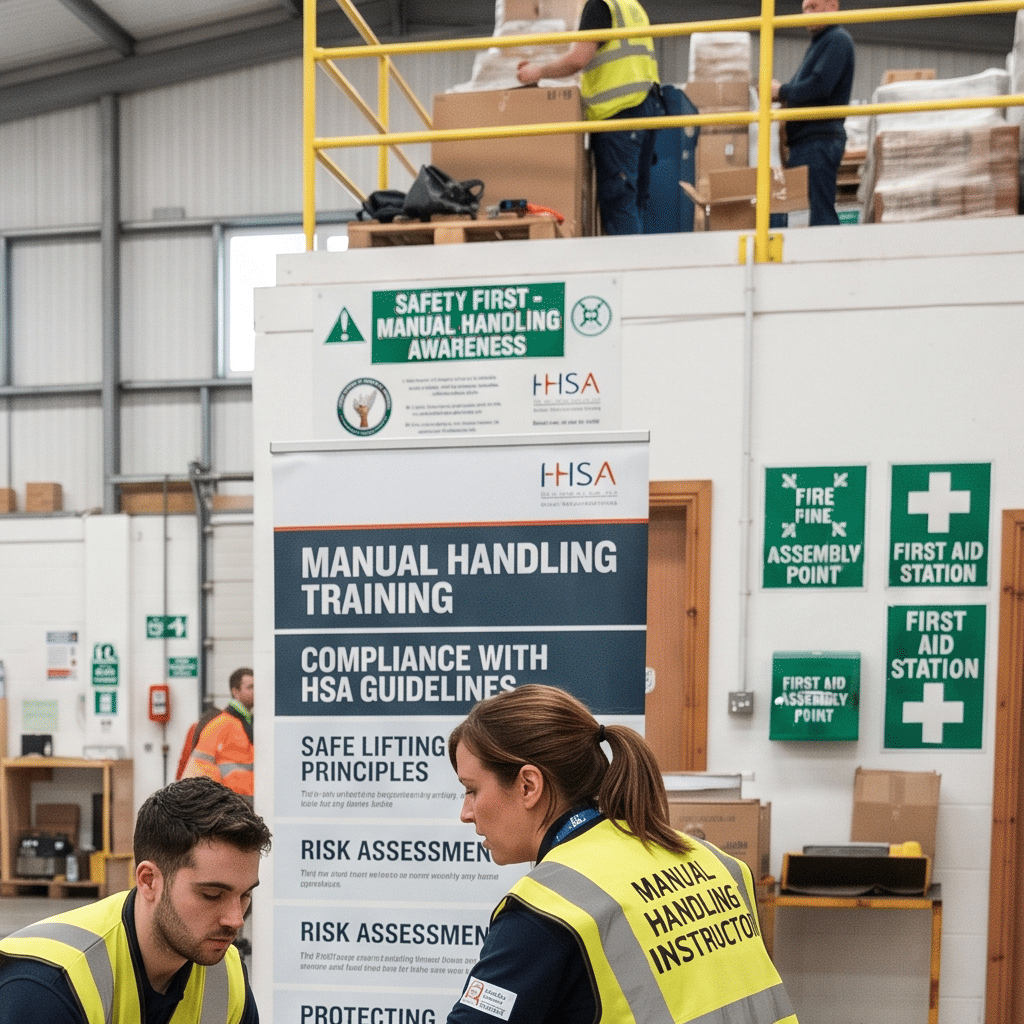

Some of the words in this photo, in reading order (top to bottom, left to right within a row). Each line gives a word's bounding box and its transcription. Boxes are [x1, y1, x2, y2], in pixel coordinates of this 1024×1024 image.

[394, 290, 467, 315] SAFETY
[472, 287, 530, 312] FIRST
[377, 314, 458, 339] MANUAL
[460, 308, 562, 335] HANDLING
[407, 334, 528, 360] AWARENESS
[795, 487, 835, 506] FIRE
[301, 544, 439, 579] MANUAL
[447, 540, 618, 576] HANDLING
[767, 544, 862, 564] ASSEMBLY
[893, 541, 948, 561] FIRST
[950, 541, 984, 561] AID
[786, 565, 843, 585] POINT
[900, 563, 977, 583] STATION
[301, 581, 454, 616] TRAINING
[906, 610, 967, 632] FIRST
[918, 634, 955, 655] AID
[301, 644, 471, 673] COMPLIANCE
[478, 644, 549, 671] WITH
[891, 658, 979, 680] STATION
[301, 676, 353, 703] HSA
[782, 676, 821, 690] FIRST
[824, 676, 846, 690] AID
[794, 708, 835, 724] POINT
[300, 735, 355, 757] SAFE
[362, 735, 446, 757] LIFTING
[301, 760, 429, 782] PRINCIPLES
[301, 839, 351, 861] RISK
[357, 840, 491, 863] ASSESSMEN
[631, 861, 717, 903] MANUAL
[643, 884, 741, 937] HANDLING
[300, 921, 350, 943] RISK
[356, 923, 489, 946] ASSESSMEN
